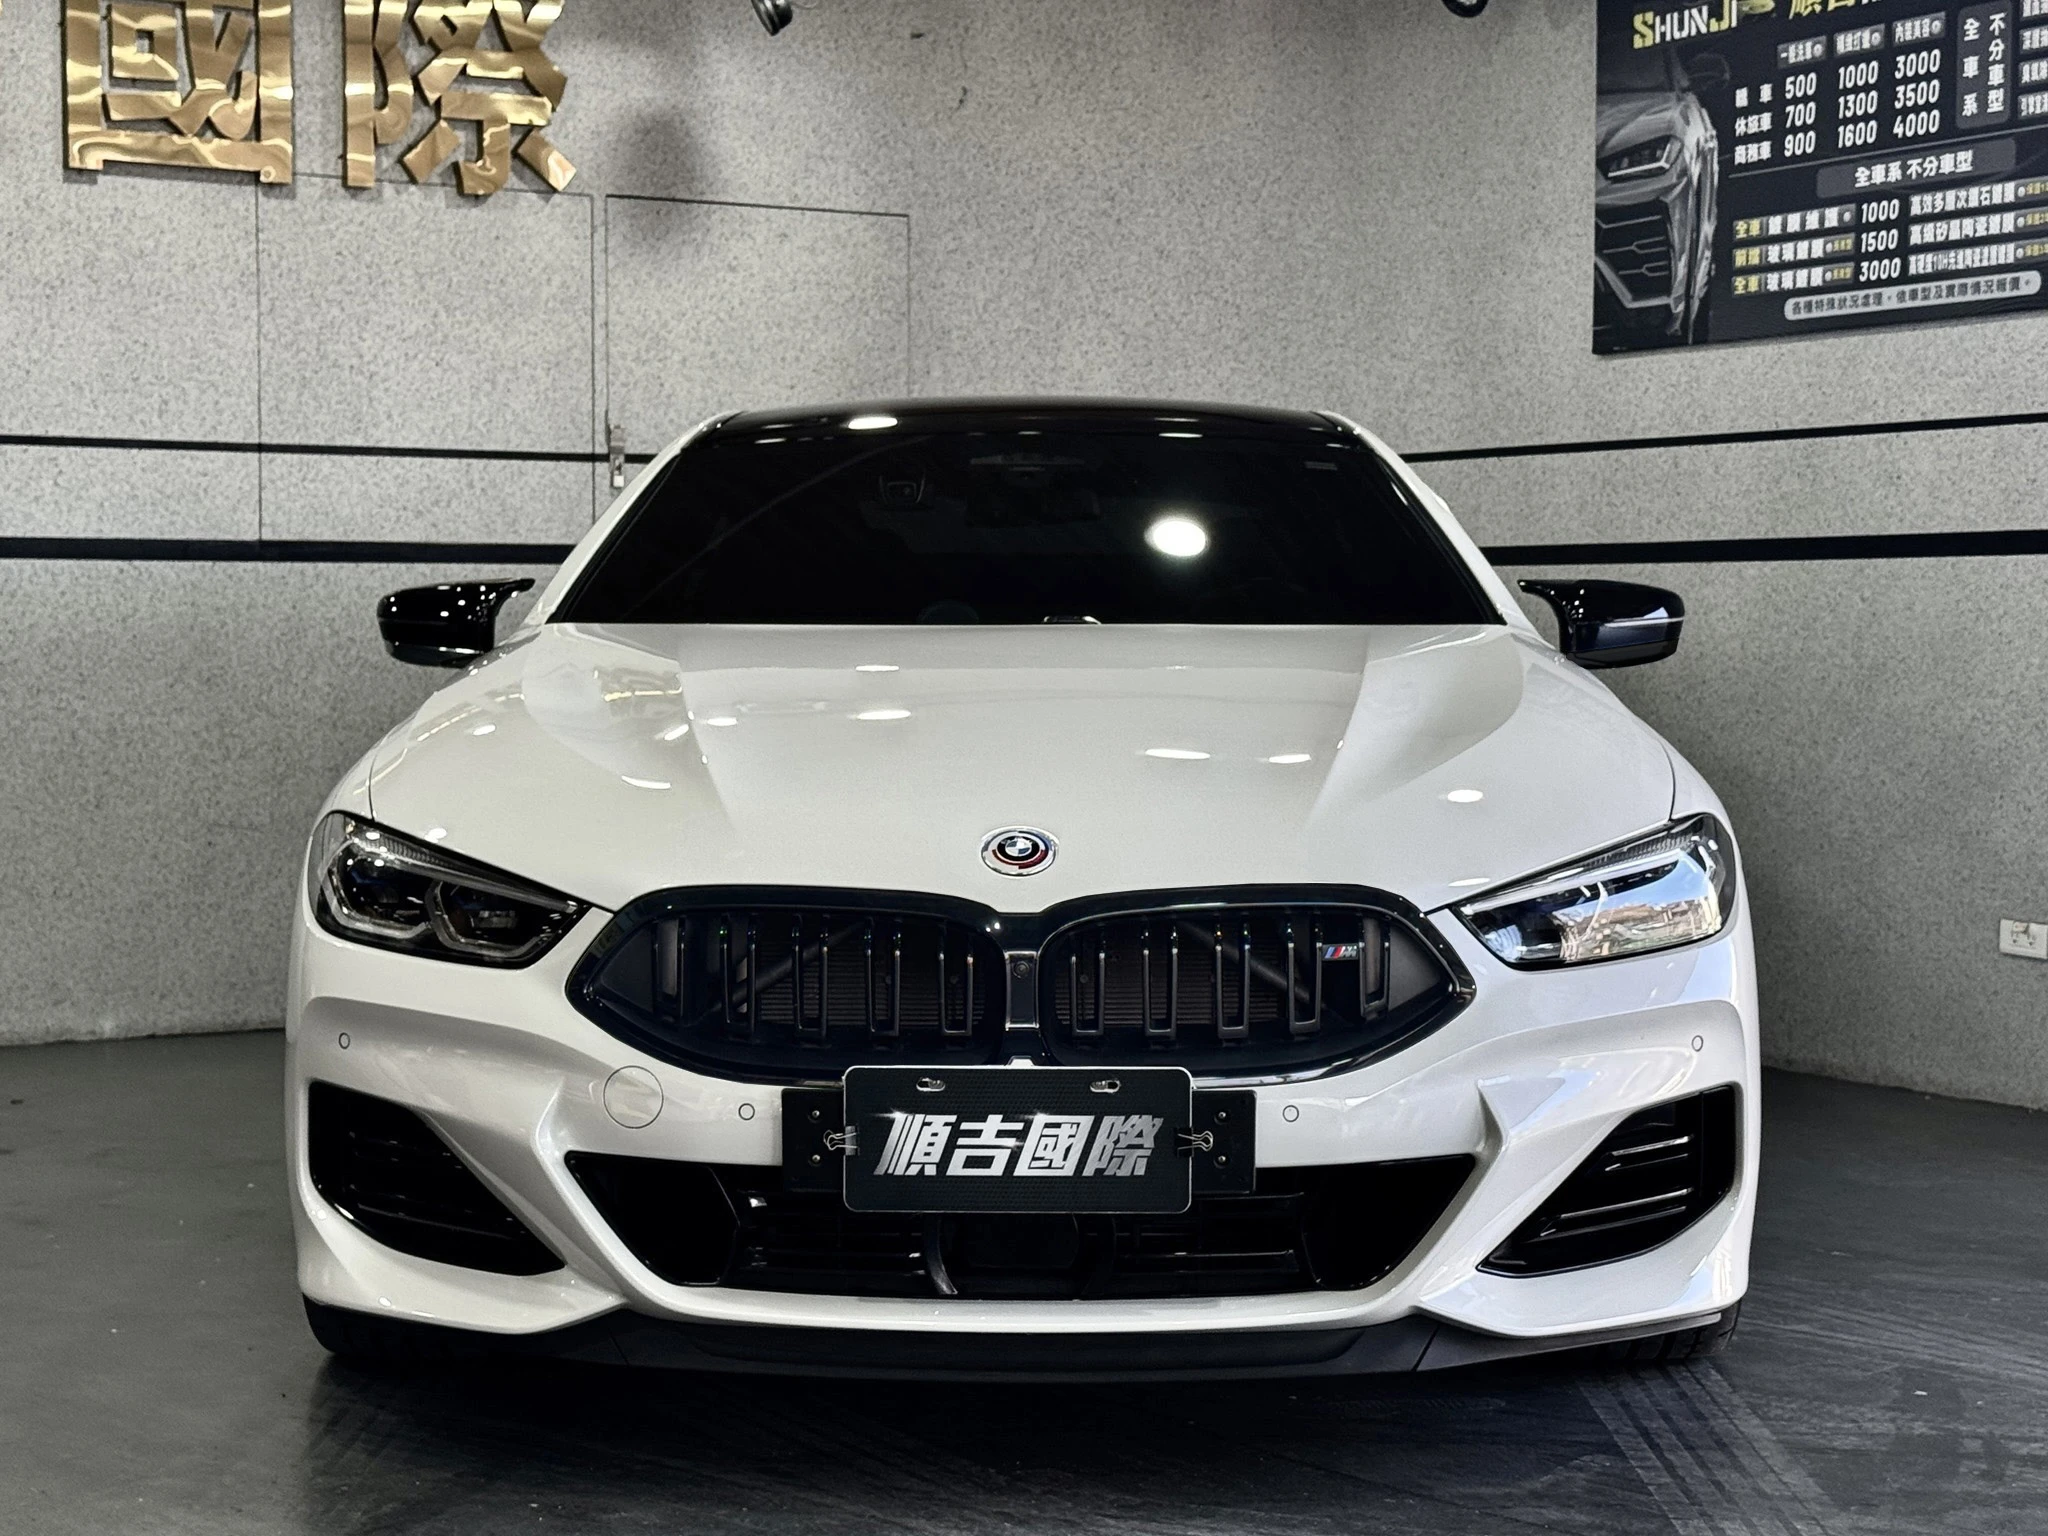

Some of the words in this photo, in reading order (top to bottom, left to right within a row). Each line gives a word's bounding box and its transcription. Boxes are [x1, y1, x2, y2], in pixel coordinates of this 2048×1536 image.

[1785, 72, 1817, 99] 500
[1838, 60, 1879, 90] 1000
[1894, 48, 1941, 79] 3000
[1987, 12, 2008, 114] 不分車型
[1785, 101, 1817, 129] 700
[1838, 90, 1878, 120] 1300
[1894, 79, 1940, 109] 3500
[1784, 130, 1816, 158] 900
[1837, 120, 1878, 149] 1600
[1892, 109, 1940, 139] 4000
[1855, 161, 1903, 188] 全車系
[1907, 150, 1974, 180] 不分車型
[1861, 198, 1900, 224] 1000
[1860, 228, 1899, 254] 1500
[1858, 257, 1902, 282] 3000
[873, 1114, 1164, 1176] 順吉國際
